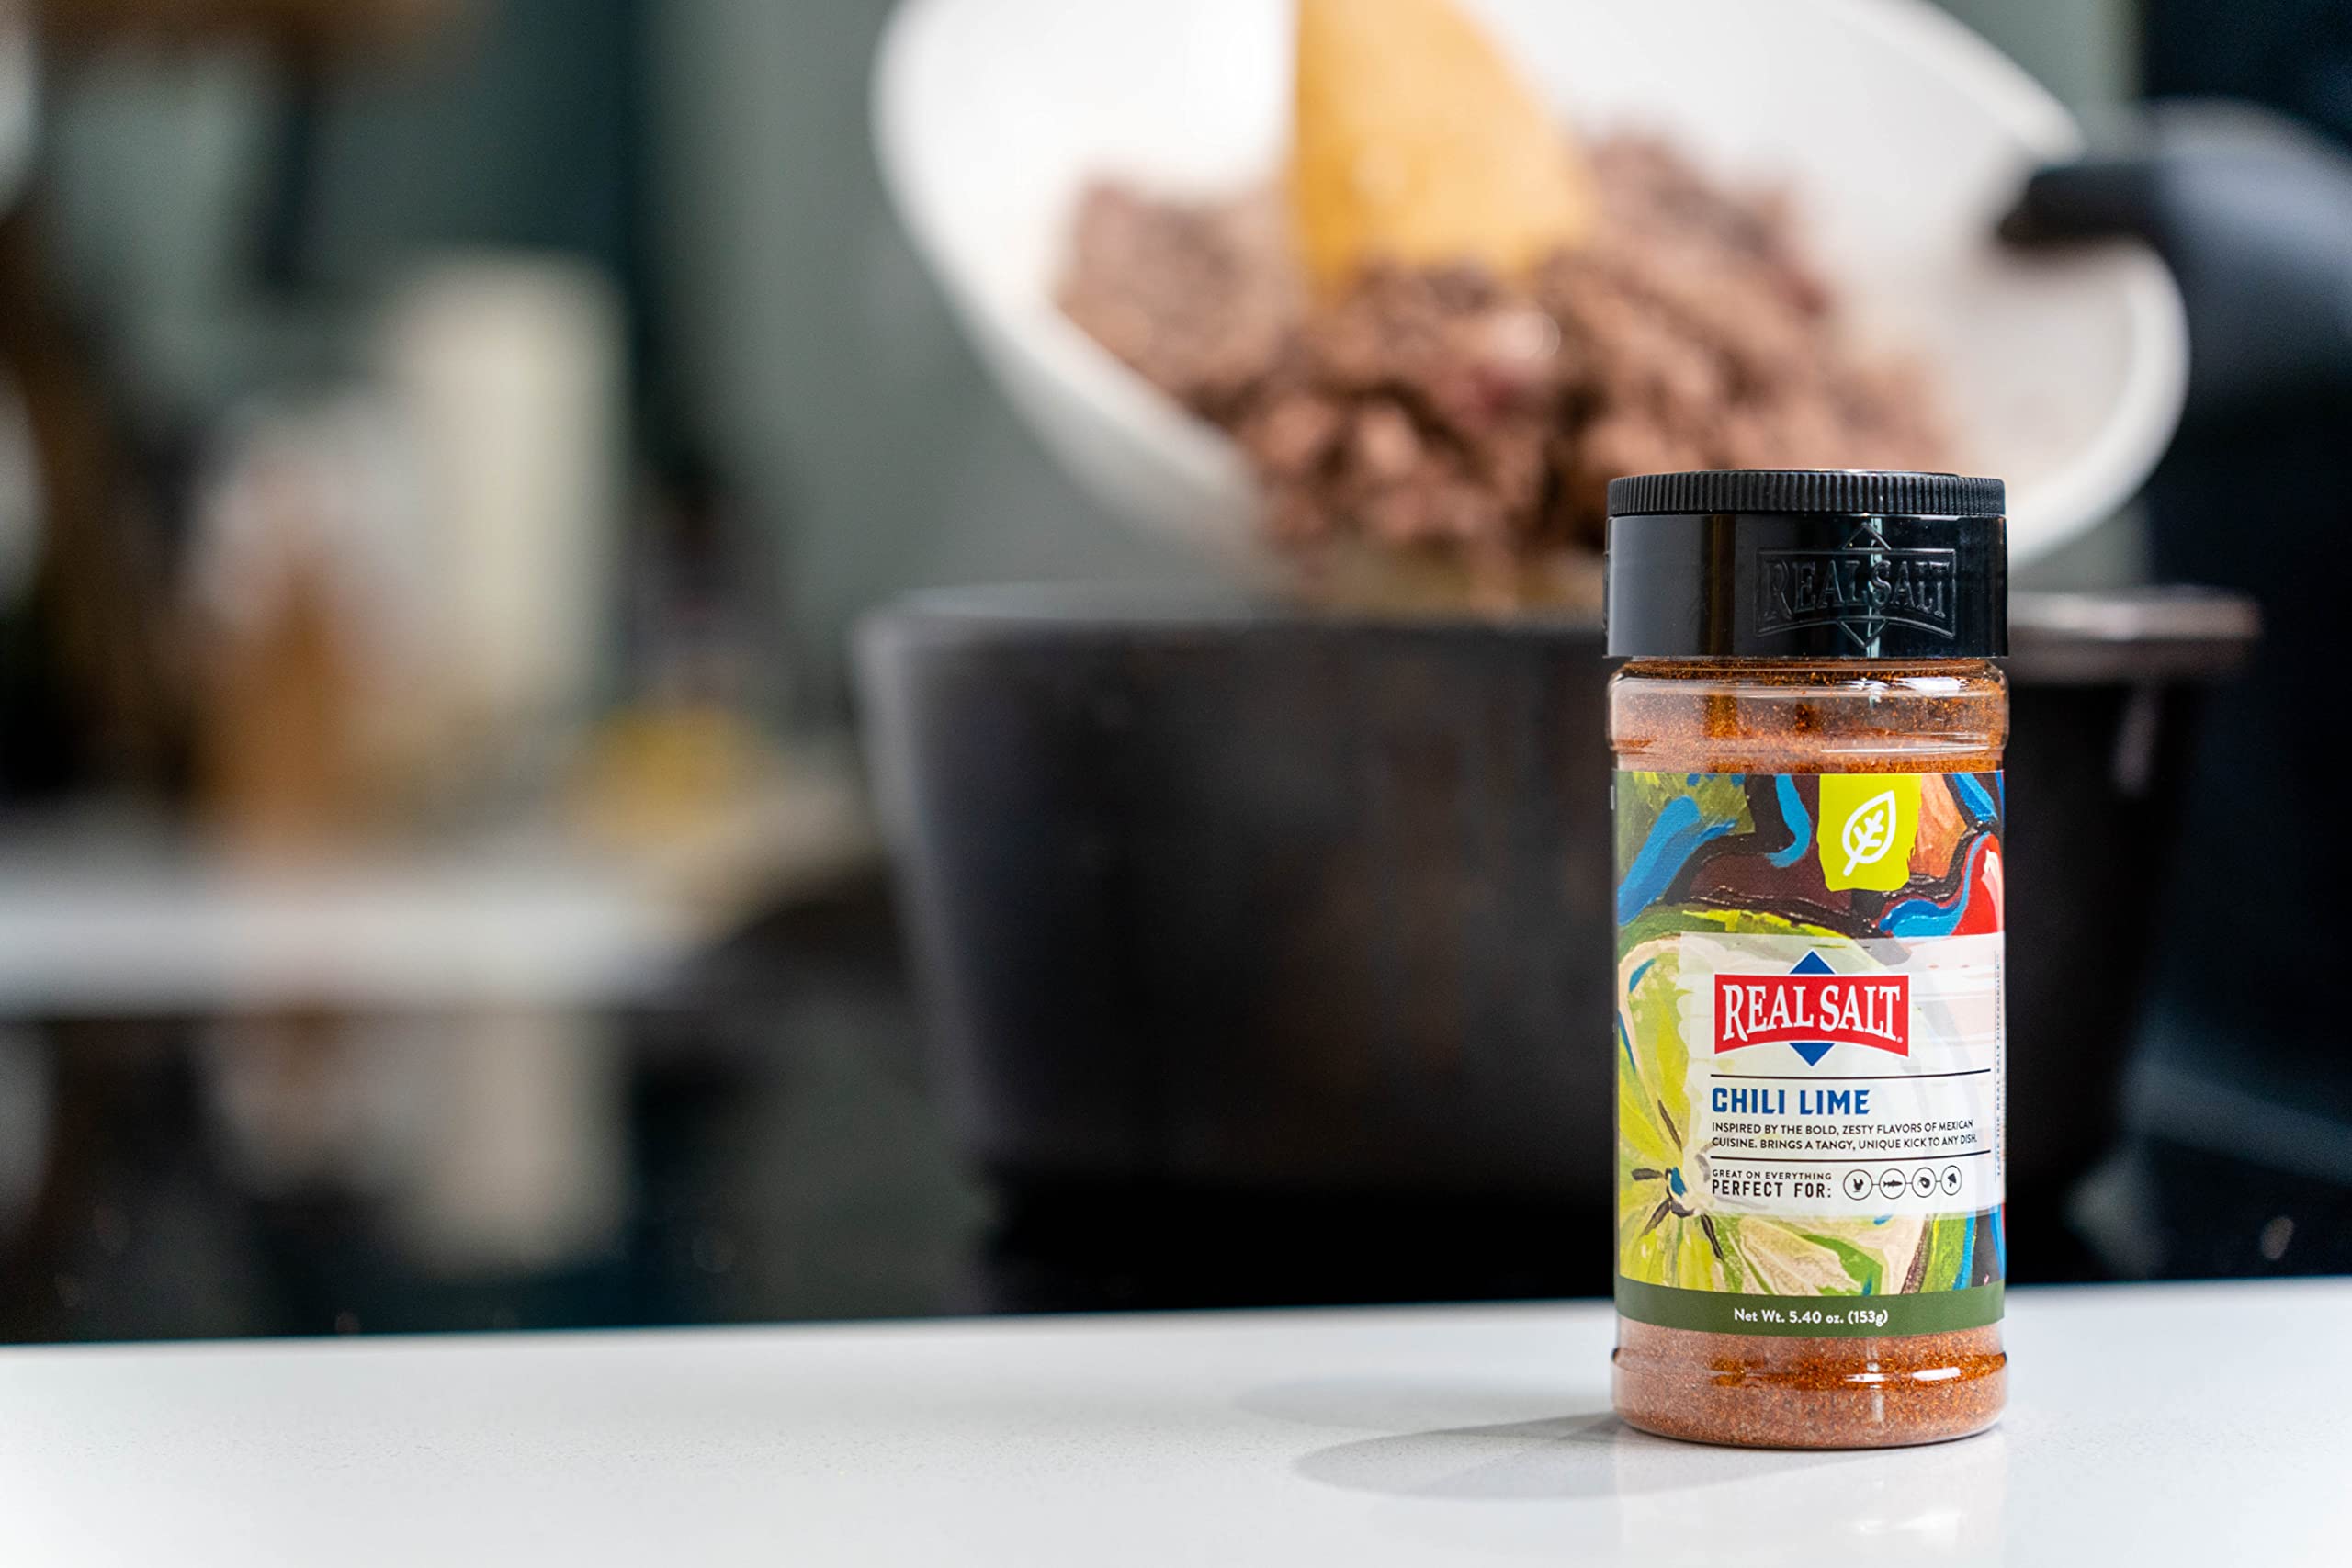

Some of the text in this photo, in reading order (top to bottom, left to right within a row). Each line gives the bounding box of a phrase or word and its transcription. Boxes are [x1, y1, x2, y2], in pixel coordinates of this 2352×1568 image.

[1761, 559, 1950, 621] REAL SALT
[1722, 984, 1901, 1043] REAL SALT
[1712, 1087, 1871, 1116] CHILI LIME
[1712, 1119, 1973, 1137] INSPIRED BY THE BOLD, ZESTY FLAVORS OF MEXICAN
[1712, 1133, 1978, 1152] CUISINE. BRINGS A TANGY, UNIQUE KICK TO ANY DISH.
[1712, 1168, 1832, 1180] GREAT ON EVERYTHING
[1712, 1179, 1832, 1199] PERFECT FOR:
[1734, 1307, 1889, 1328] Net Wt. 5.40 oz. (153g)
